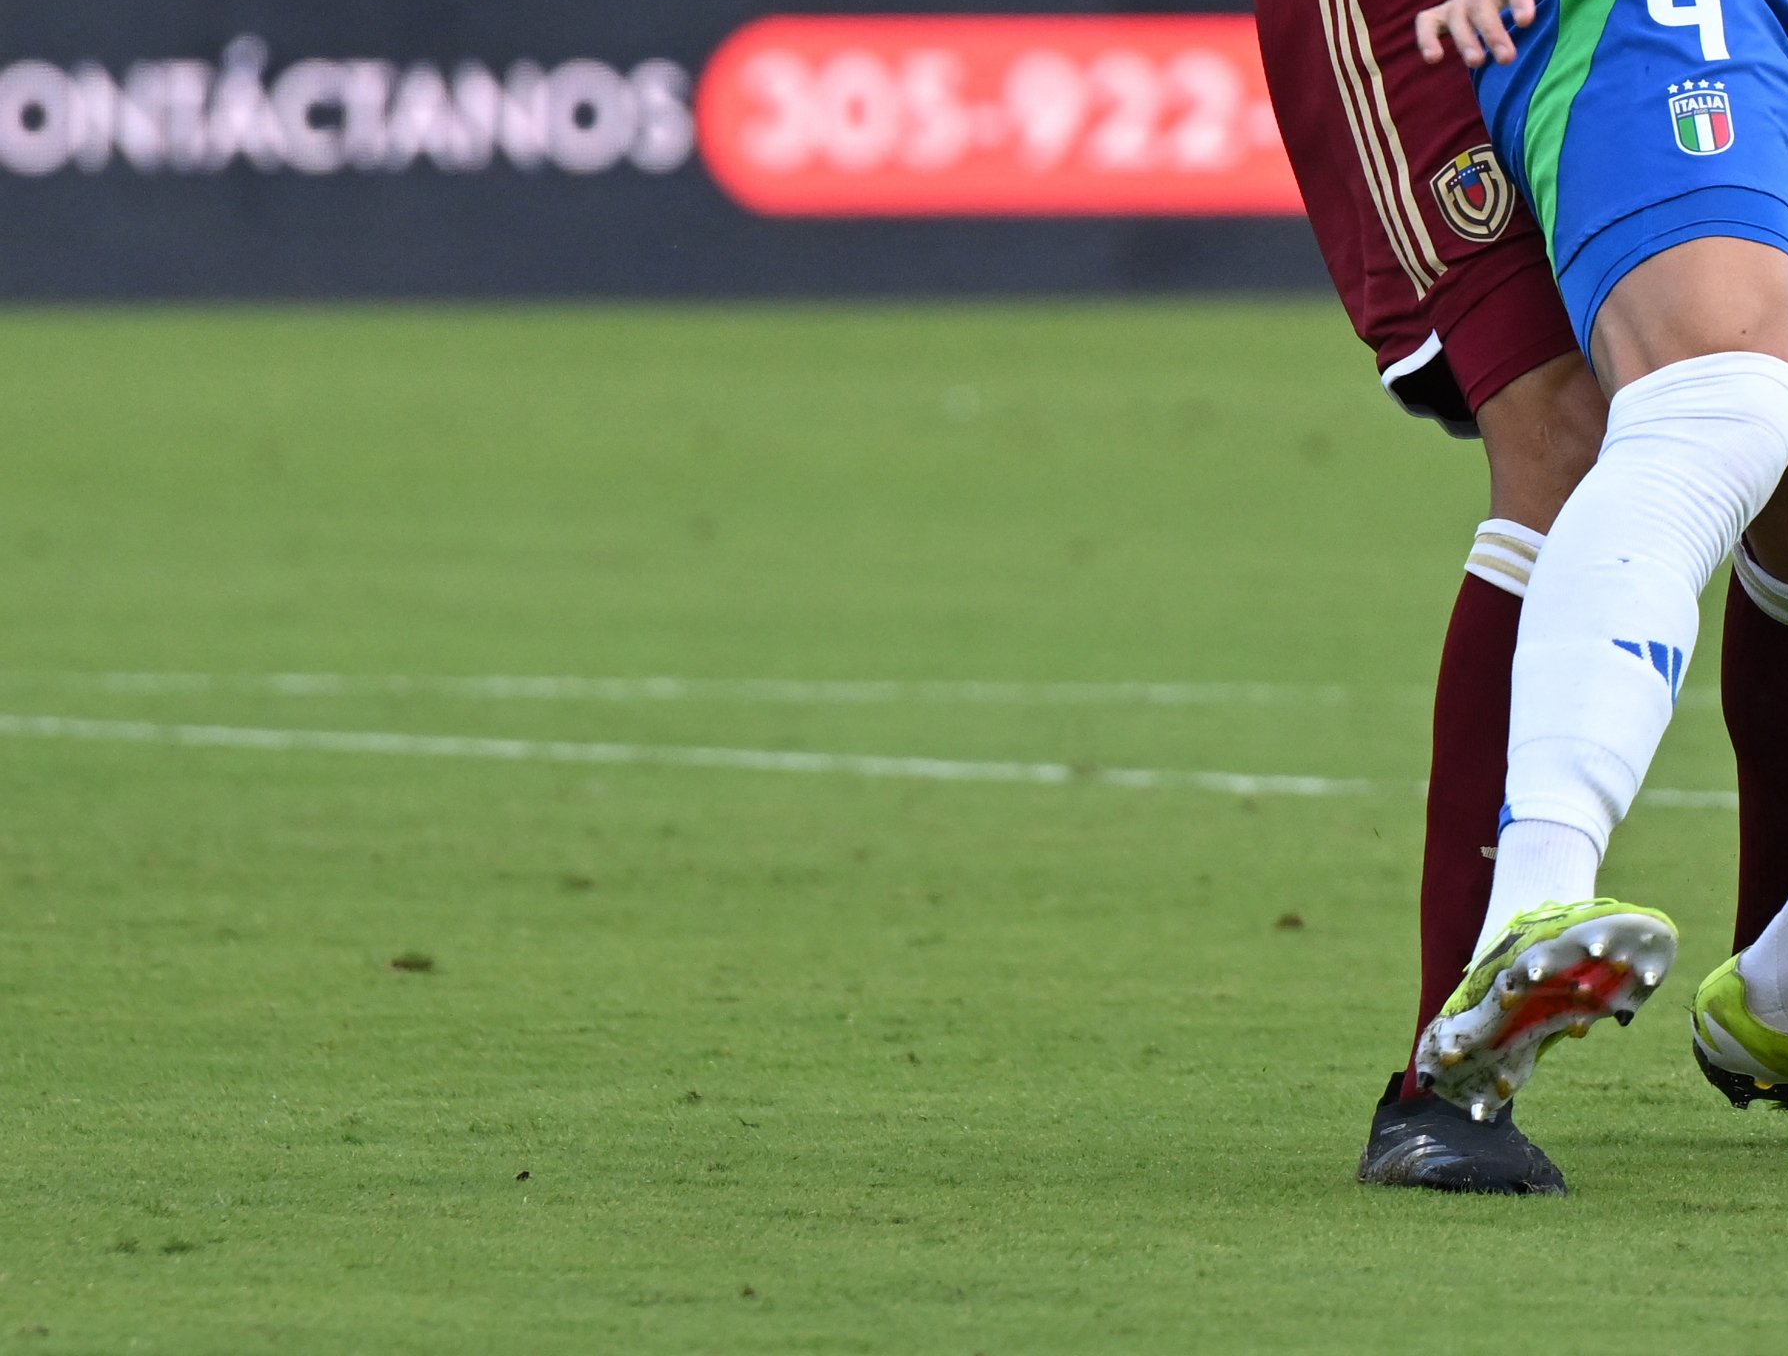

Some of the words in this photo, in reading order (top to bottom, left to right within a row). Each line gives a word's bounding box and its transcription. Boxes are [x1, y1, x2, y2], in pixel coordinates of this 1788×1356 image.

[0, 34, 694, 175] ONTÁCTANOS
[738, 49, 1287, 174] 305-922-
[1674, 95, 1725, 114] ITALIA
